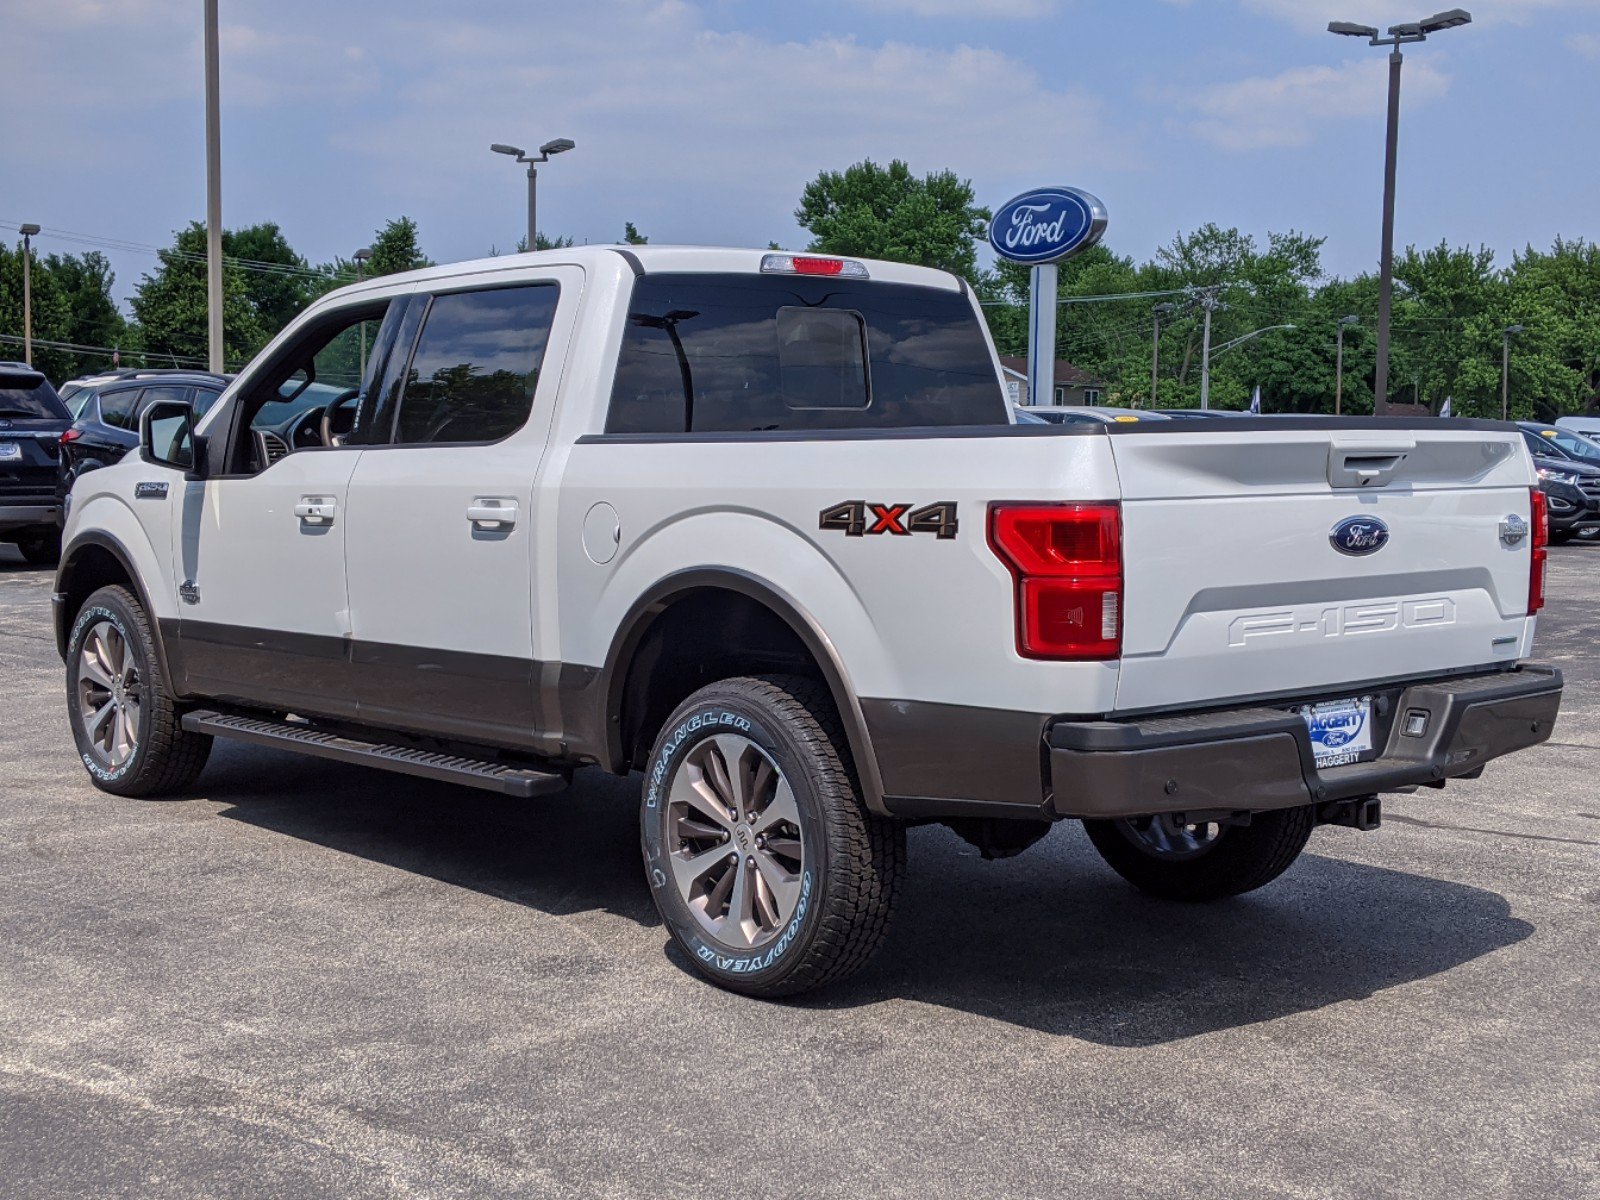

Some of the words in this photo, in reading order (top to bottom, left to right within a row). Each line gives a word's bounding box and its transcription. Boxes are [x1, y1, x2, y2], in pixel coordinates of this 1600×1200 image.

[1006, 203, 1067, 248] Ford
[1346, 525, 1379, 547] Ford
[1229, 597, 1457, 647] F-150
[647, 712, 750, 808] WRANGLER
[1316, 752, 1360, 768] HAGGERTY
[1327, 732, 1345, 745] Ford
[697, 870, 811, 972] GOODYEAR
